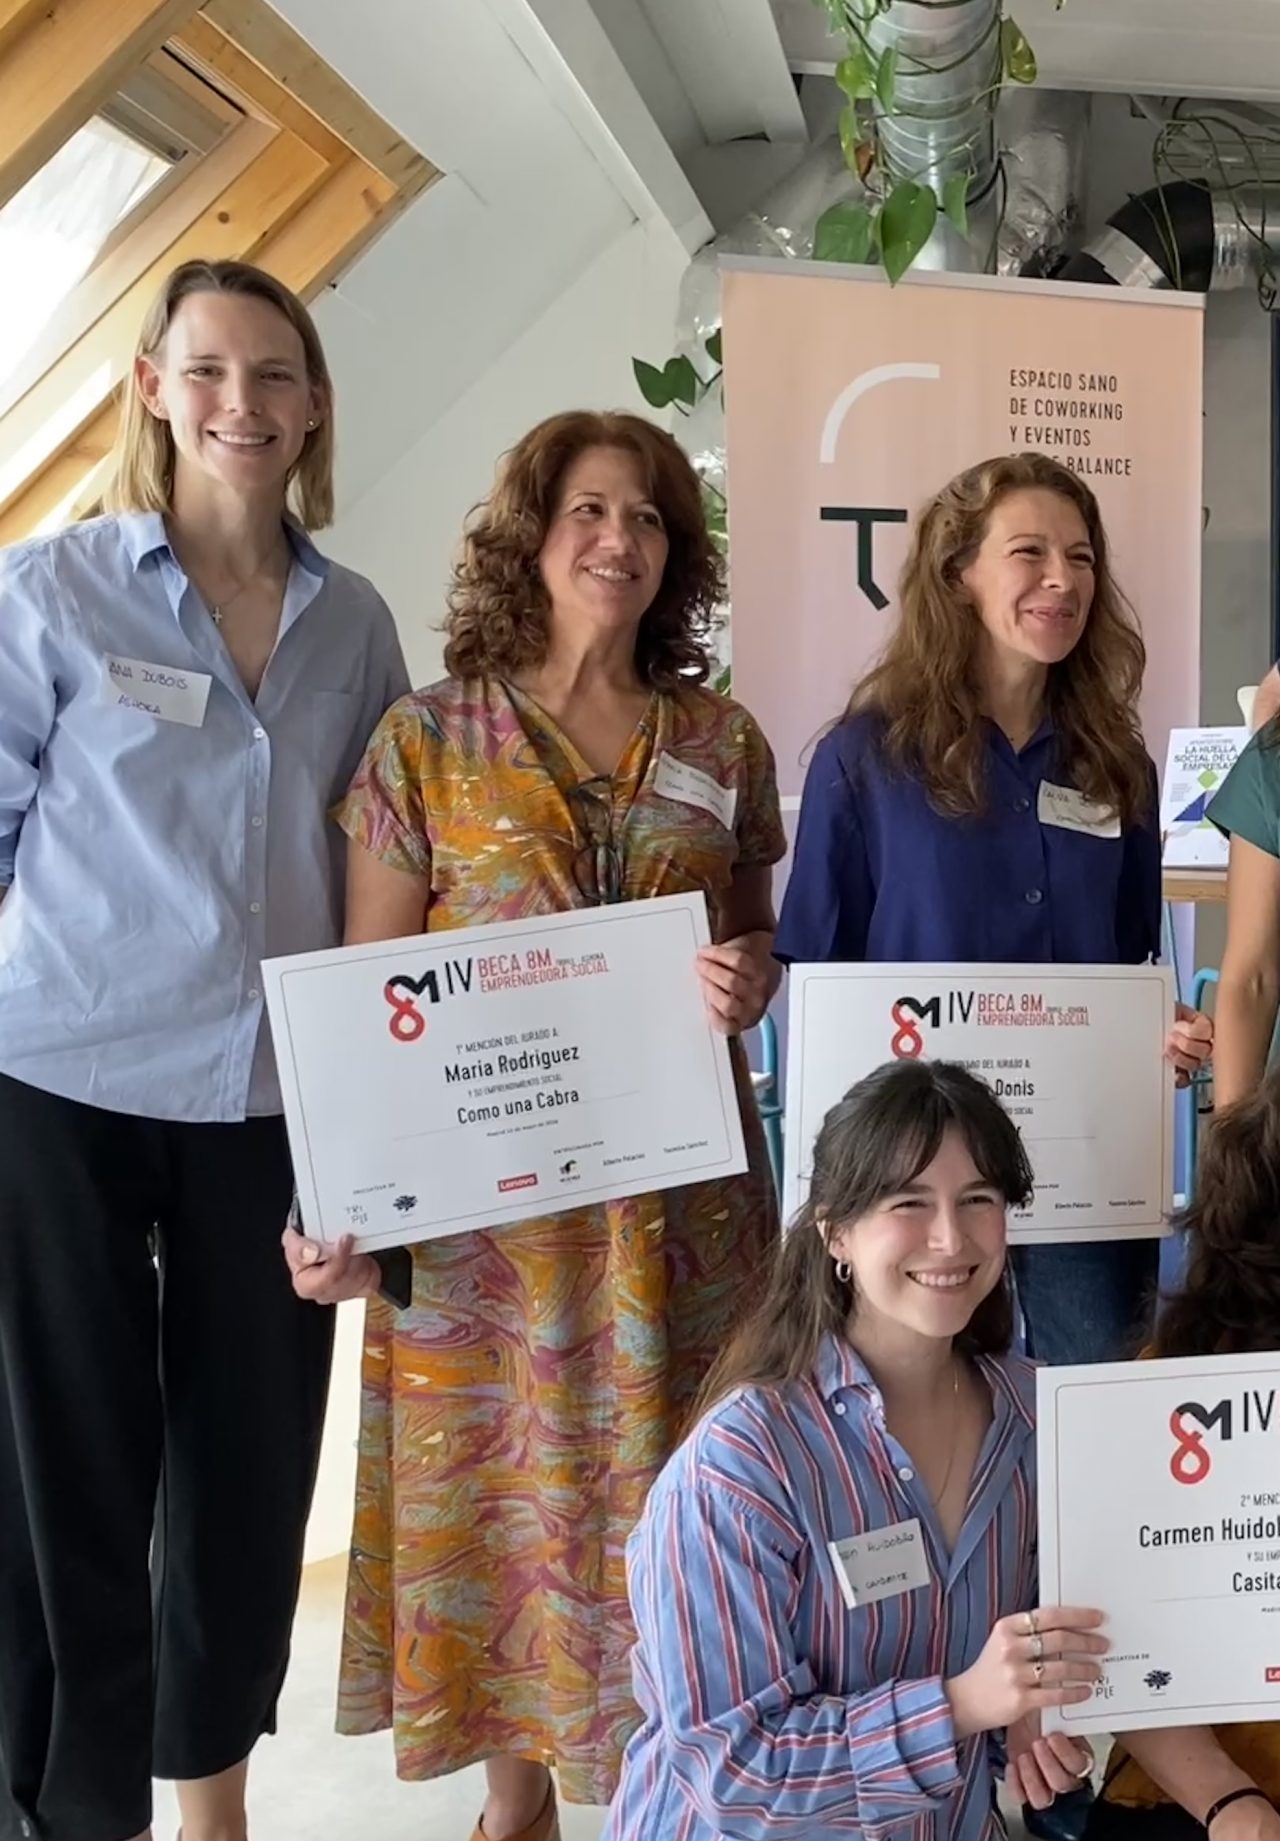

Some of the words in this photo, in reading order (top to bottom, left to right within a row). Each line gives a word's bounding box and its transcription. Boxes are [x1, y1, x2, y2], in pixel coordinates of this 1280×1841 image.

[1010, 369, 1072, 391] ESPACIO
[1078, 372, 1118, 393] SANO
[1010, 398, 1028, 416] DE
[1034, 399, 1124, 421] COWORKING
[1009, 425, 1018, 443] Y
[1025, 427, 1091, 447] EVENTOS
[1067, 456, 1132, 476] BALANCE
[445, 957, 473, 995] IV
[477, 953, 522, 978] BECA
[526, 948, 553, 970] 8M
[481, 966, 569, 993] EMPRENDEDORA
[572, 960, 610, 978] SOCIAL
[949, 990, 975, 1024] IV
[977, 993, 1015, 1012] BECA
[1020, 993, 1043, 1012] 8M
[977, 1012, 1055, 1027] EMPRENDEDORA
[1058, 1011, 1091, 1026] SOCIAL
[457, 1105, 500, 1125] Como
[505, 1098, 533, 1116] una
[536, 1089, 580, 1109] Cabra
[1243, 1389, 1275, 1433] IV
[1139, 1524, 1215, 1548] Carmen
